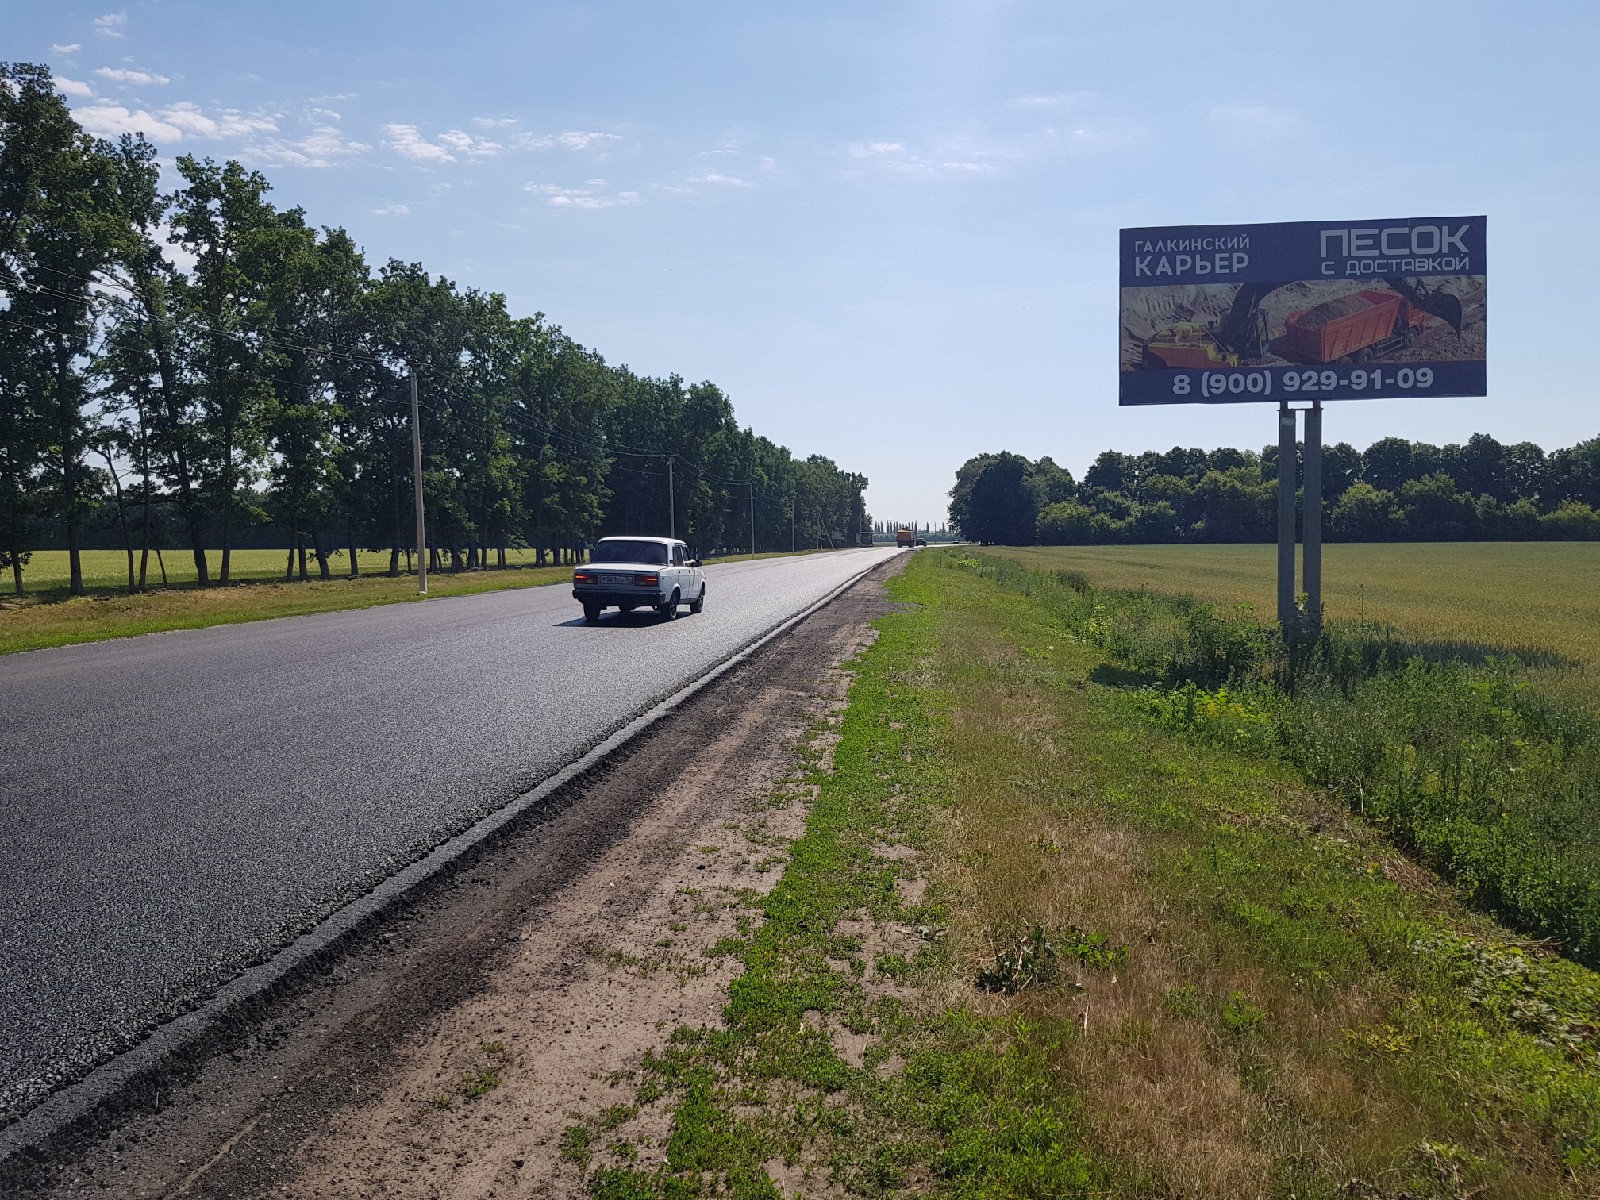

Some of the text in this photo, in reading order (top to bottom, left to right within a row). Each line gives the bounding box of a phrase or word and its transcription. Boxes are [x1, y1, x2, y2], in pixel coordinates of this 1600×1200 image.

[1135, 233, 1250, 254] ГАЛКИНСКИЙ
[1321, 225, 1471, 257] ПЕСОК
[1135, 253, 1250, 277] КАРЬЕР
[1345, 256, 1470, 276] ДОСТАВКОЙ
[1173, 367, 1434, 397] 8 (900) 929-91-09
